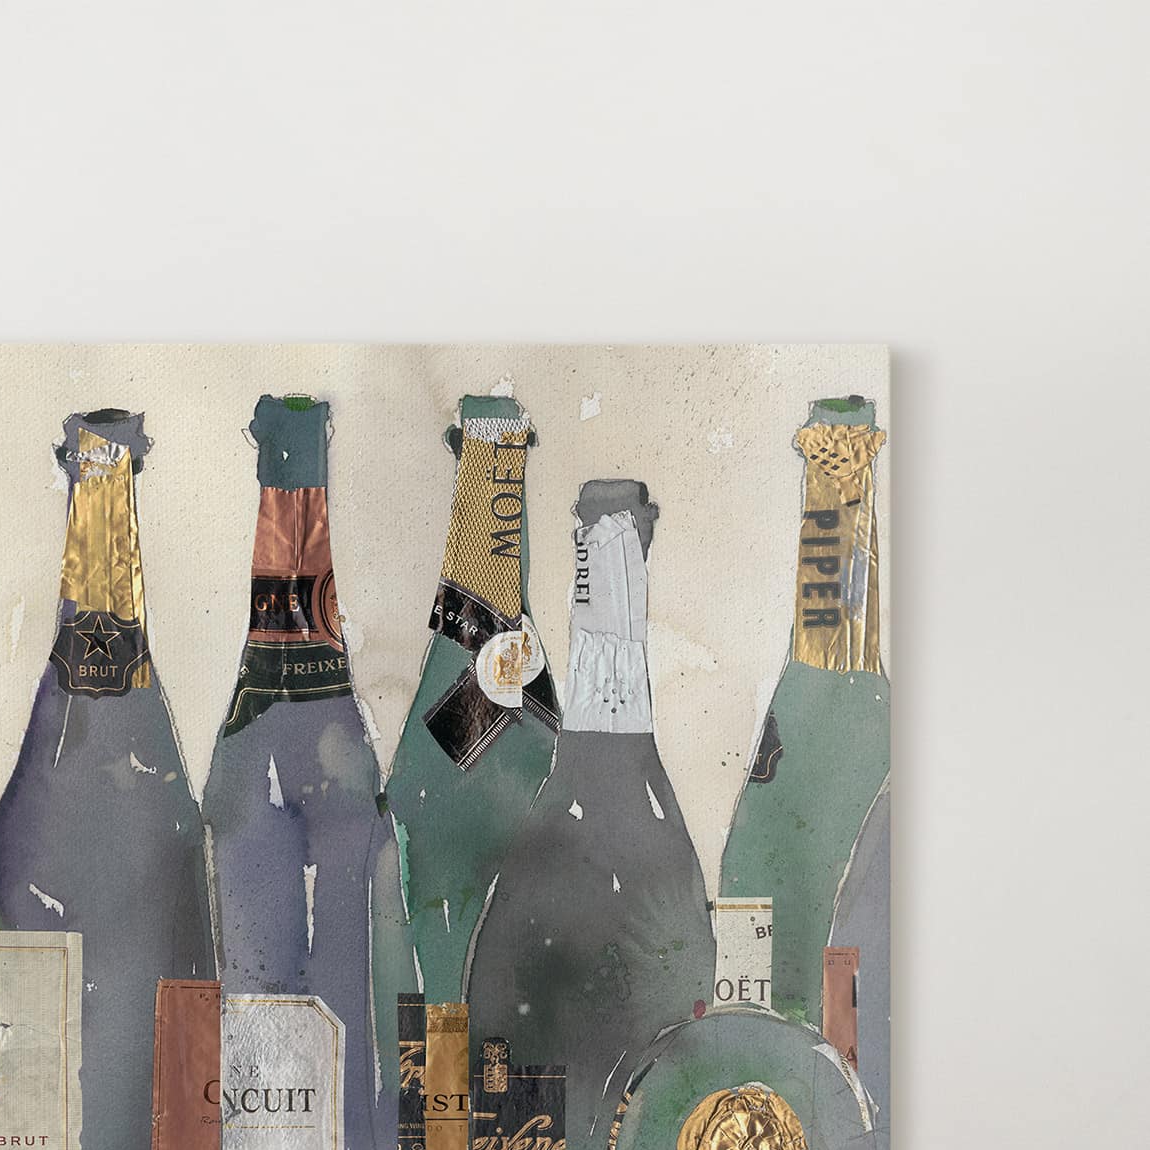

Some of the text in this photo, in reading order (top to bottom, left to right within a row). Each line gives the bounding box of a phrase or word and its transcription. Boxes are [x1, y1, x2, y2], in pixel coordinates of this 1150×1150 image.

[486, 441, 528, 559] MOËT
[801, 509, 842, 629] PIPER
[446, 611, 479, 636] STAR
[79, 664, 118, 677] BRUT
[283, 656, 347, 676] FREIXE
[715, 975, 771, 1002] OËT
